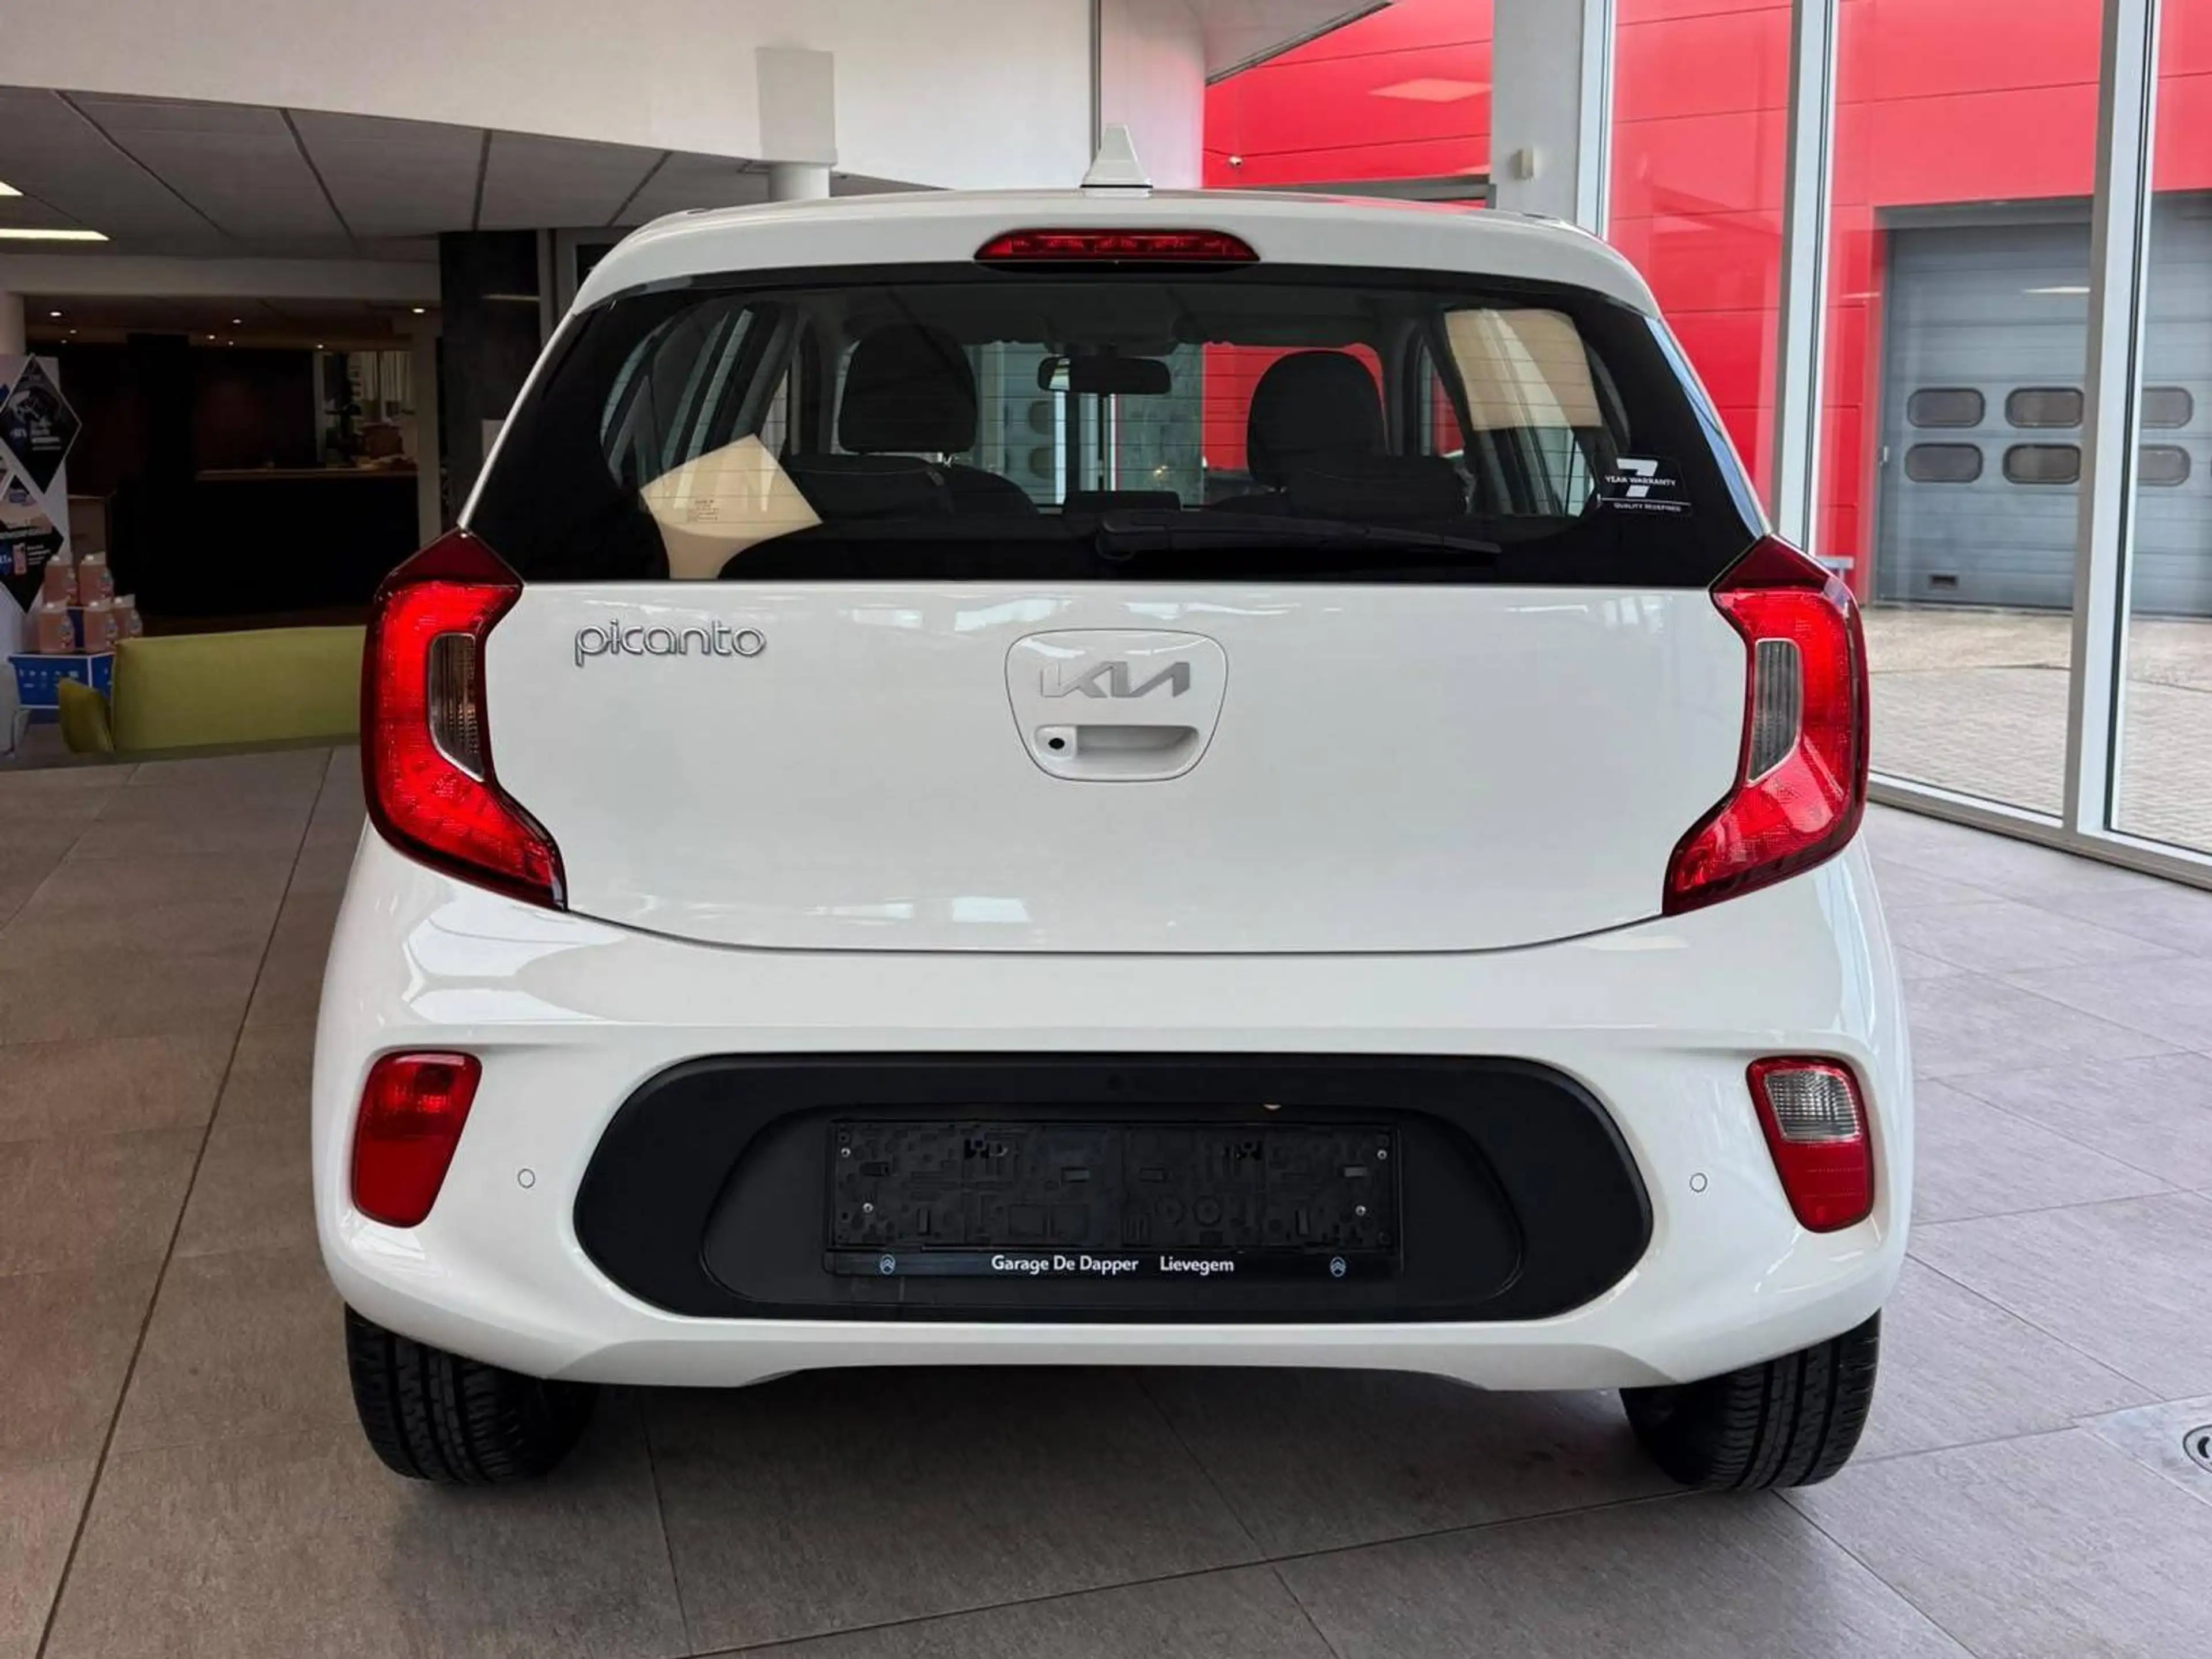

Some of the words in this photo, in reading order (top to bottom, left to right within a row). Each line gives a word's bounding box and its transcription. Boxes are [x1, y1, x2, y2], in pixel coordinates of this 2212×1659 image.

[1605, 475, 1628, 483] YEAR
[1628, 477, 1676, 486] WARRANTY
[1616, 458, 1658, 497] 7
[574, 618, 767, 667] picanto
[1040, 661, 1191, 698] KIA
[991, 1255, 1049, 1275] Garage
[1054, 1255, 1075, 1271] De
[1080, 1255, 1139, 1275] Dapper
[1160, 1256, 1234, 1275] Lievegem
